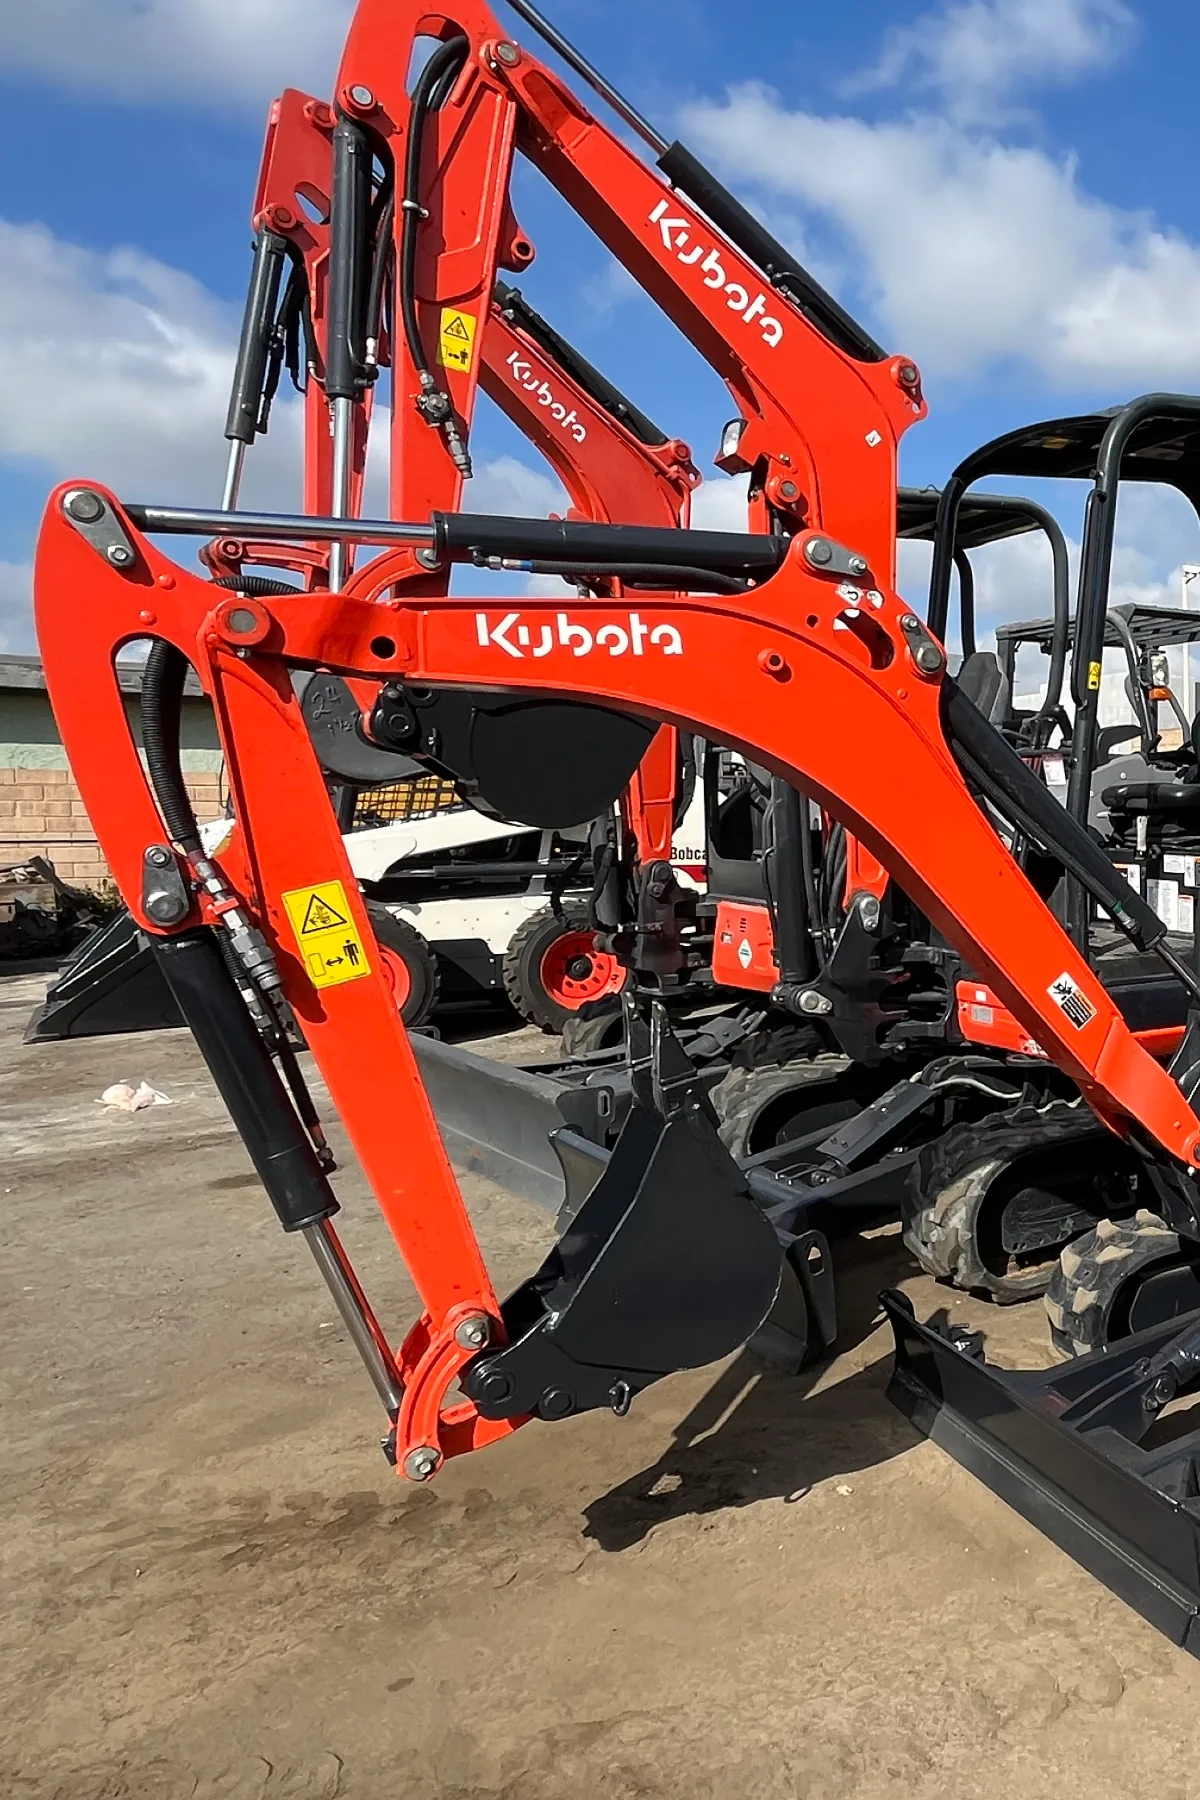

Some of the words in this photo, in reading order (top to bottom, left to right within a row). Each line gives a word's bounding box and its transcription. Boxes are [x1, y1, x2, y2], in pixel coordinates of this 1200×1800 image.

[648, 199, 783, 348] Kubota
[506, 350, 586, 443] Kubota
[475, 613, 683, 658] Kubota
